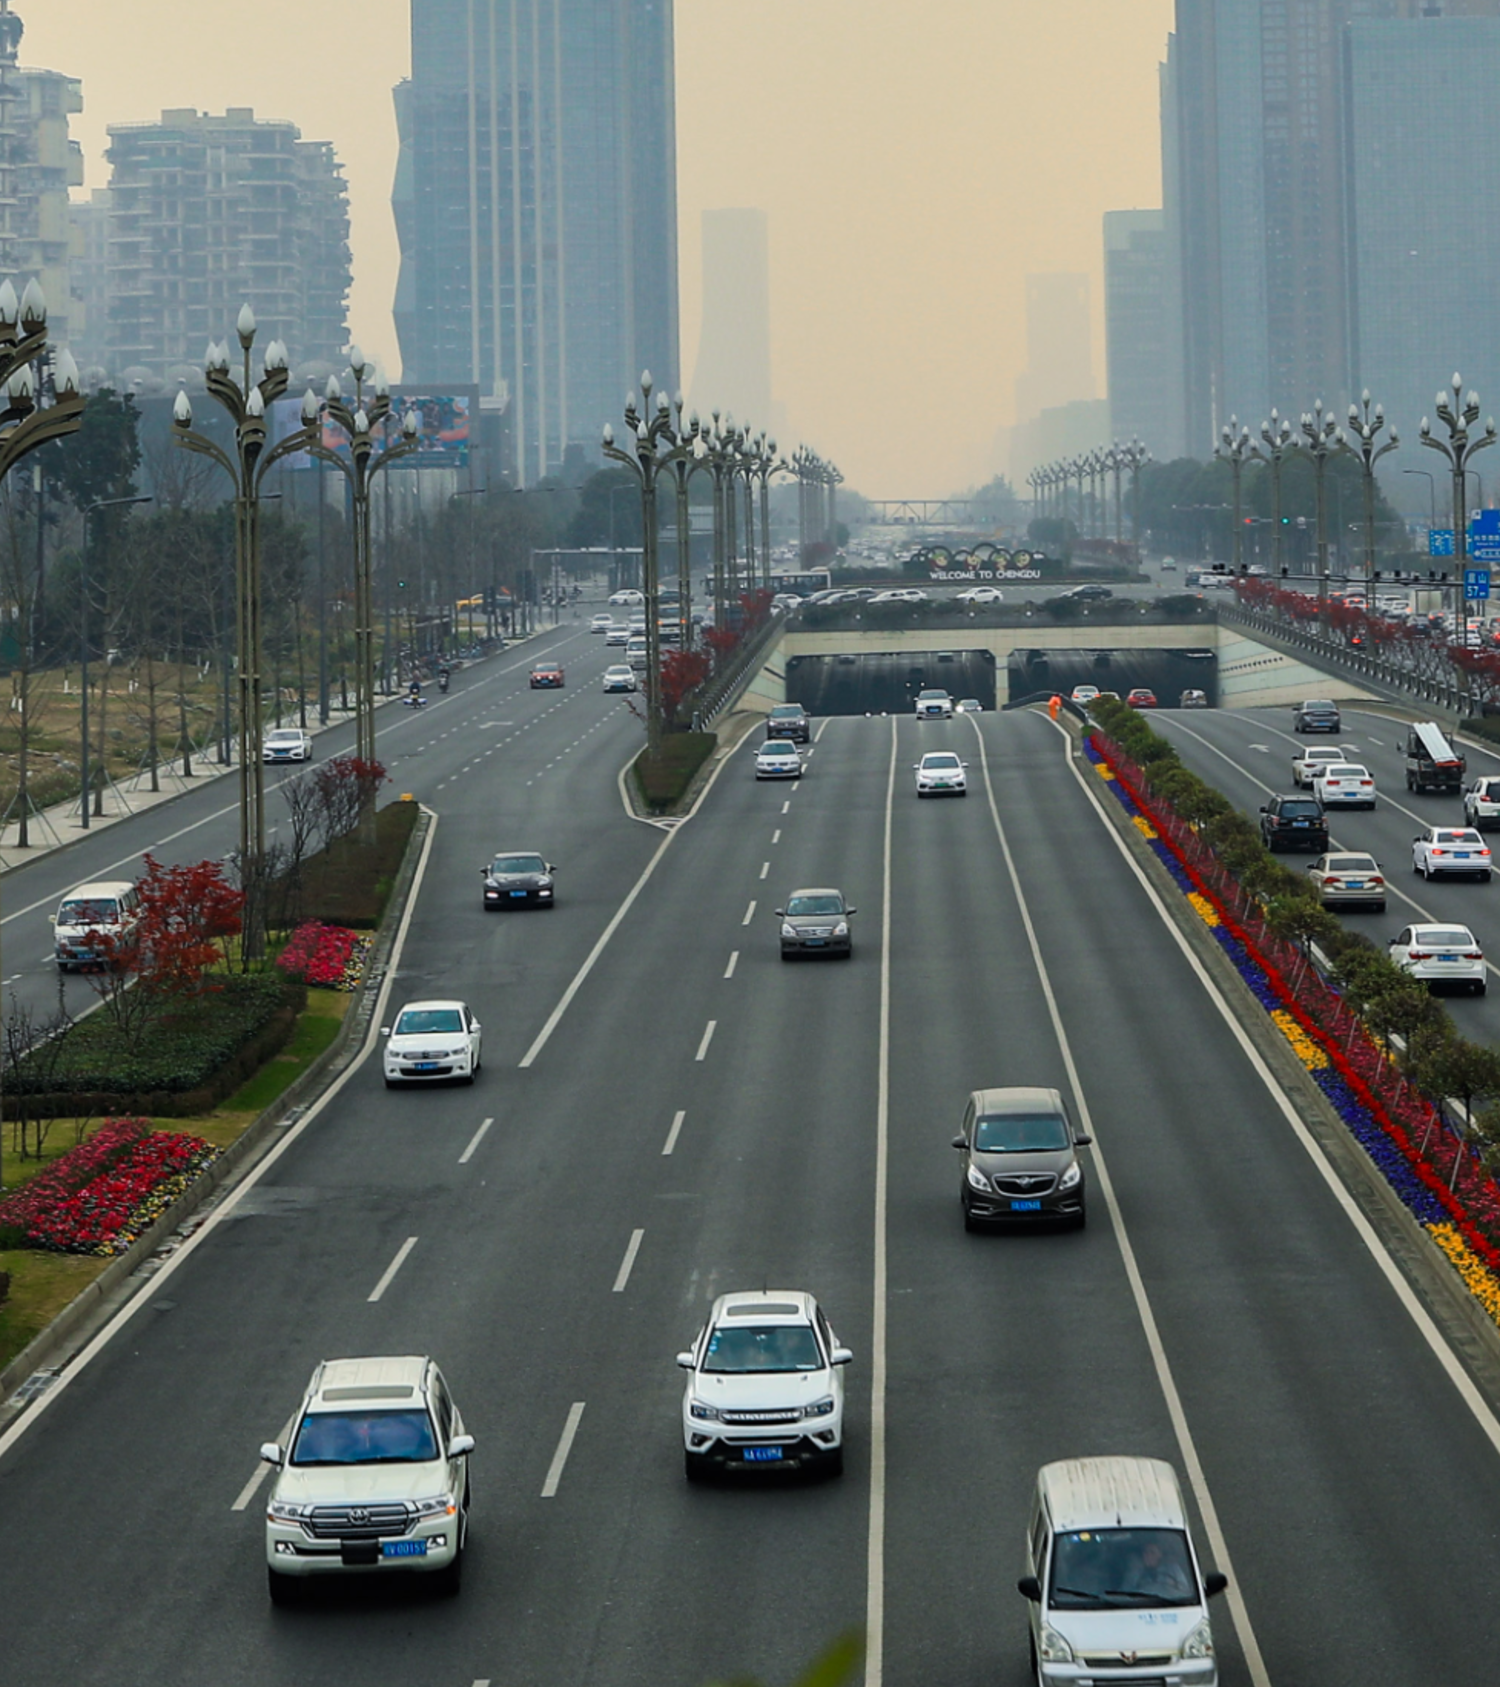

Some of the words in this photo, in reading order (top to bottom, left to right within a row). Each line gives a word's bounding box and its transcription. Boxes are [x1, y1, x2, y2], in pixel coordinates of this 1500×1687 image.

[929, 571, 975, 579] WELCOME
[979, 571, 992, 579] TO
[996, 570, 1041, 579] CHENGDU
